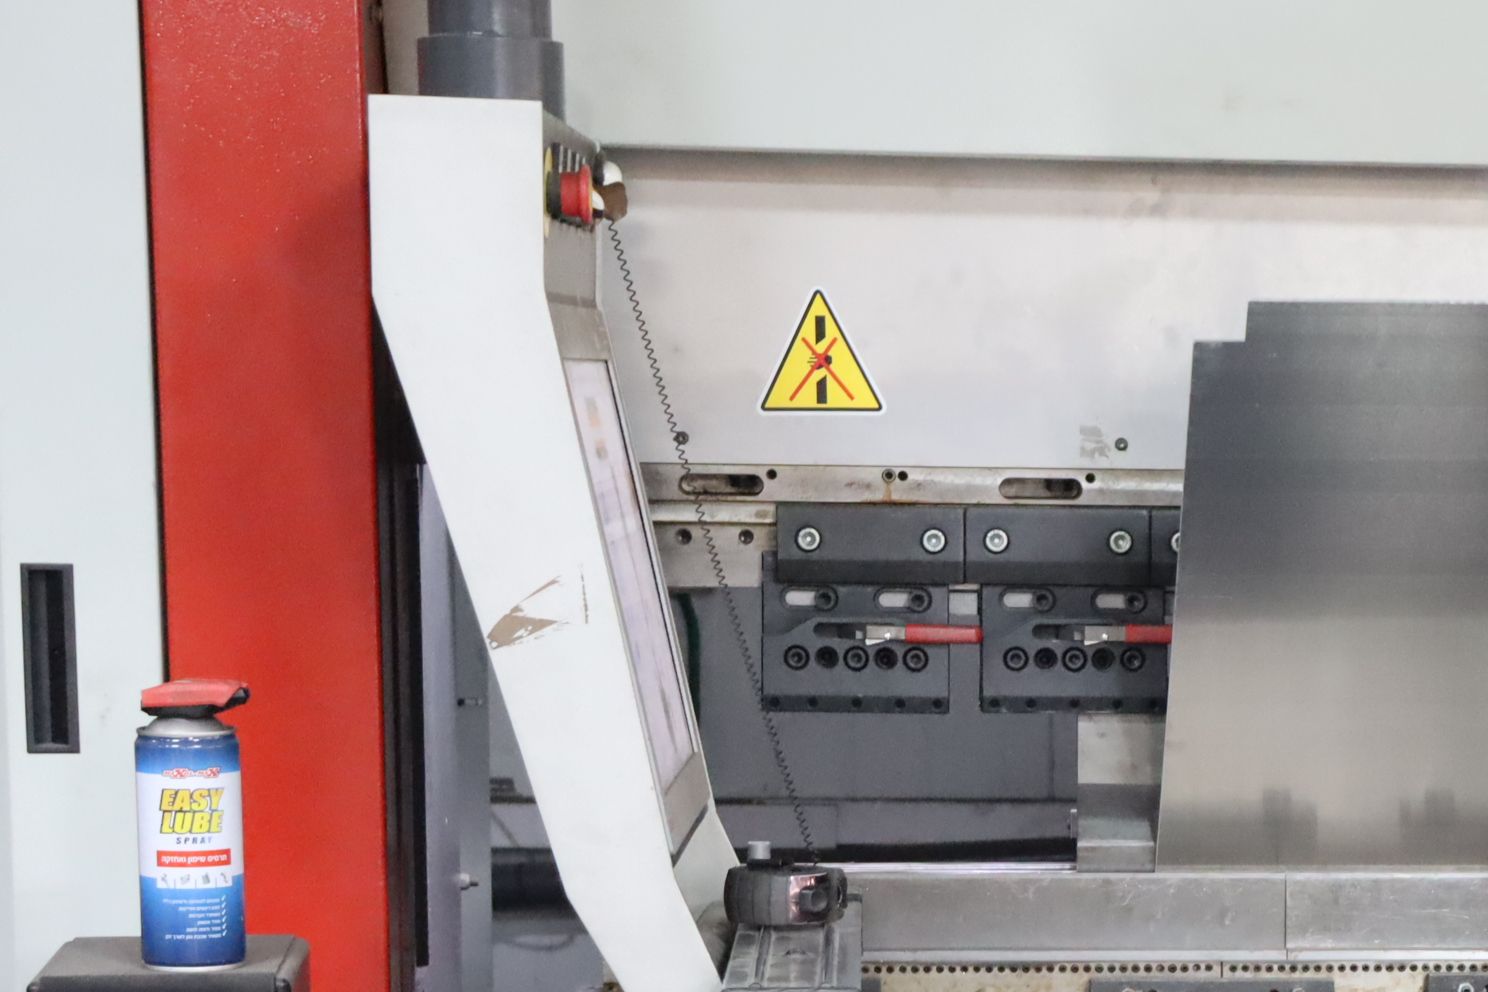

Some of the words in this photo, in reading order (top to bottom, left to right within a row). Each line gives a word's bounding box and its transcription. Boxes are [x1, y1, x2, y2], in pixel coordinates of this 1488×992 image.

[160, 787, 224, 811] EASY
[160, 811, 224, 834] LUBE
[176, 837, 212, 845] SPRAY
